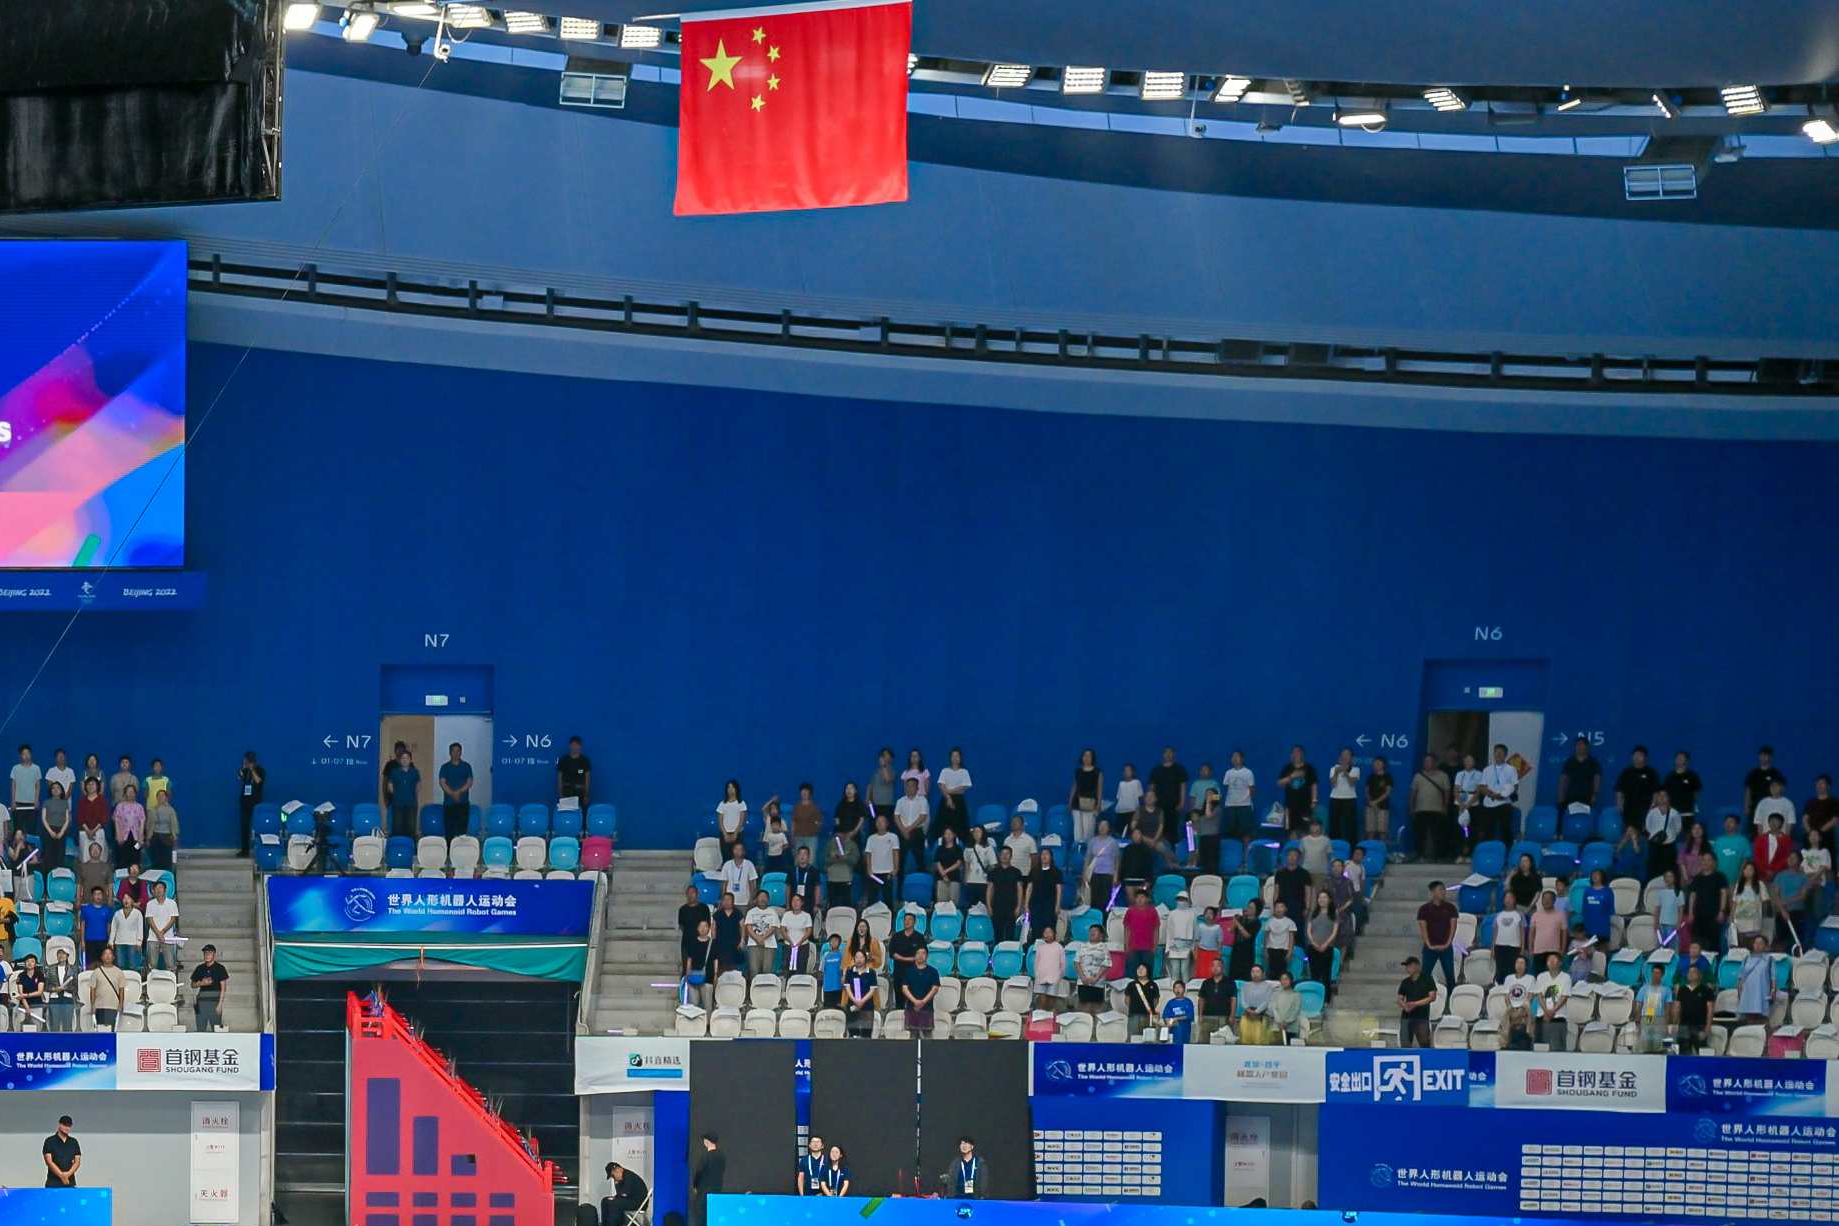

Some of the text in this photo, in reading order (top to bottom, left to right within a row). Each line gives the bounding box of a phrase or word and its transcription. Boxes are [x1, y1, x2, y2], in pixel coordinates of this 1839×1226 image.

[29, 588, 51, 596] 2022
[123, 588, 177, 598] BEIJING 2022
[424, 634, 449, 648] N7
[1474, 627, 1503, 641] N6
[346, 735, 371, 748] N7
[526, 734, 552, 748] N6
[1381, 734, 1409, 748] N6
[388, 894, 517, 908] 世界人形机器人运动会
[491, 908, 516, 916] Games
[17, 1052, 107, 1062] 世界人形机器人运动会
[166, 1049, 239, 1065] 首钢基金
[1078, 1062, 1173, 1073] 世界人形机器人运动会
[1330, 1069, 1465, 1092] 安全出口 EXIT
[1558, 1070, 1637, 1089] 首钢基金
[1558, 1088, 1637, 1098] SHOUGANG FUND
[1722, 1123, 1836, 1138] 世界人形机器人运动会
[1398, 1168, 1508, 1182] 世界人形机器人运动会
